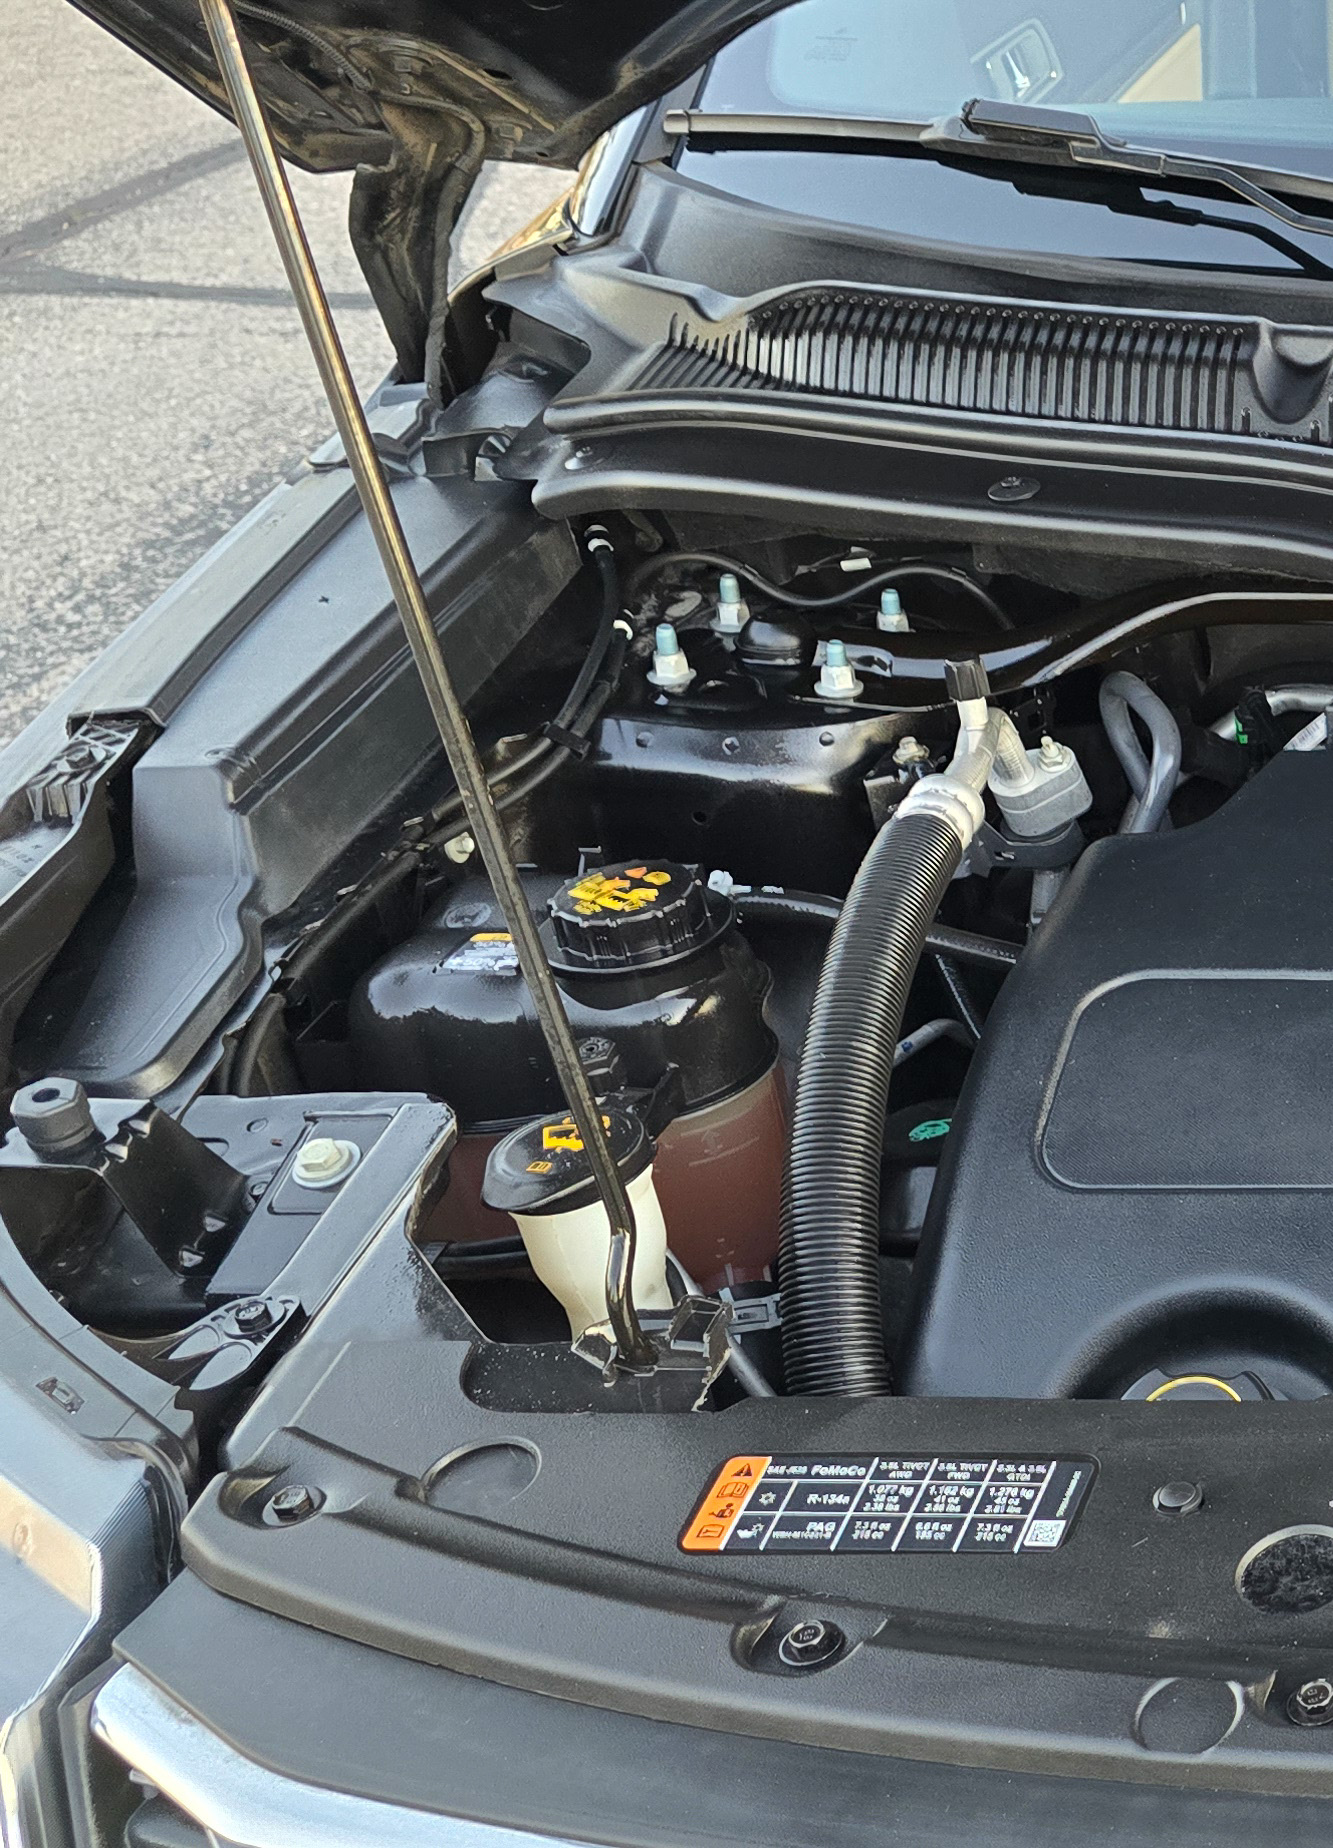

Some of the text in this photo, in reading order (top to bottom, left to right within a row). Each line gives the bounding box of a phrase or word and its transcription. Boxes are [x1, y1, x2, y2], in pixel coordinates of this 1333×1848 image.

[811, 1464, 866, 1476] FoMoCo
[869, 1484, 915, 1497] 1.077 kg
[960, 1486, 974, 1498] kg
[1019, 1487, 1034, 1500] kg
[807, 1493, 850, 1505] R-134a
[887, 1495, 900, 1503] oz
[947, 1496, 960, 1504] oz
[885, 1502, 900, 1511] lbs
[945, 1503, 961, 1512] lbs
[1005, 1505, 1022, 1513] lbs
[806, 1522, 836, 1532] PAG
[879, 1523, 891, 1531] oz
[940, 1523, 953, 1532] oz
[1001, 1524, 1014, 1533] oz
